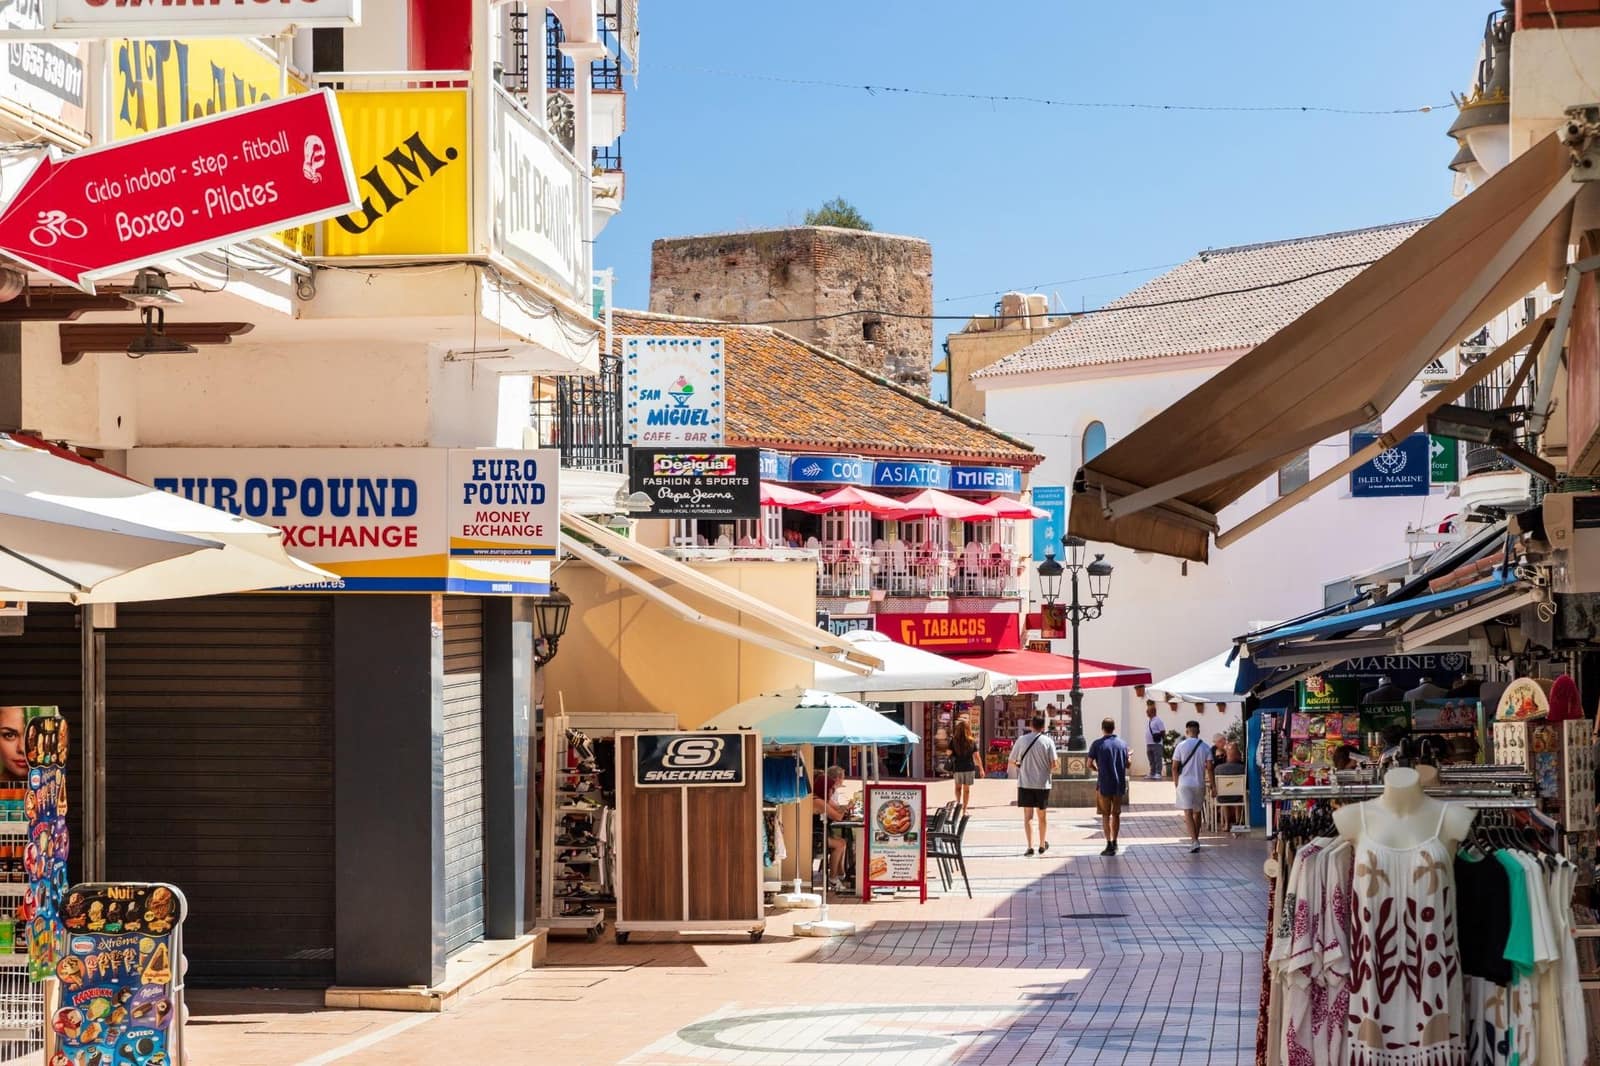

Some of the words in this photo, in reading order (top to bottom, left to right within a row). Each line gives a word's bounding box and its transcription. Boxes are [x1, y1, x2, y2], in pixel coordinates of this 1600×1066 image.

[85, 178, 122, 204] Ciclo
[124, 167, 177, 194] indoor
[191, 153, 229, 176] step
[242, 130, 290, 163] fitball
[115, 206, 185, 243] Boxeo
[204, 181, 279, 219] Pilates
[639, 389, 661, 401] SAN
[643, 432, 671, 441] CAFE
[684, 432, 708, 442] BAR
[472, 459, 537, 481] EURO
[643, 477, 691, 485] FASHION
[694, 477, 702, 485] &
[706, 477, 749, 485] SPORTS
[1358, 476, 1382, 484] BLEU
[1386, 475, 1423, 483] MARINE
[463, 483, 546, 505] POUND
[658, 487, 691, 503] Pepe
[475, 511, 531, 523] MONEY
[463, 525, 543, 537] EXCHANGE
[923, 618, 986, 636] TABACOS
[1347, 655, 1436, 671] MARINE
[644, 770, 736, 781] SKECHERS
